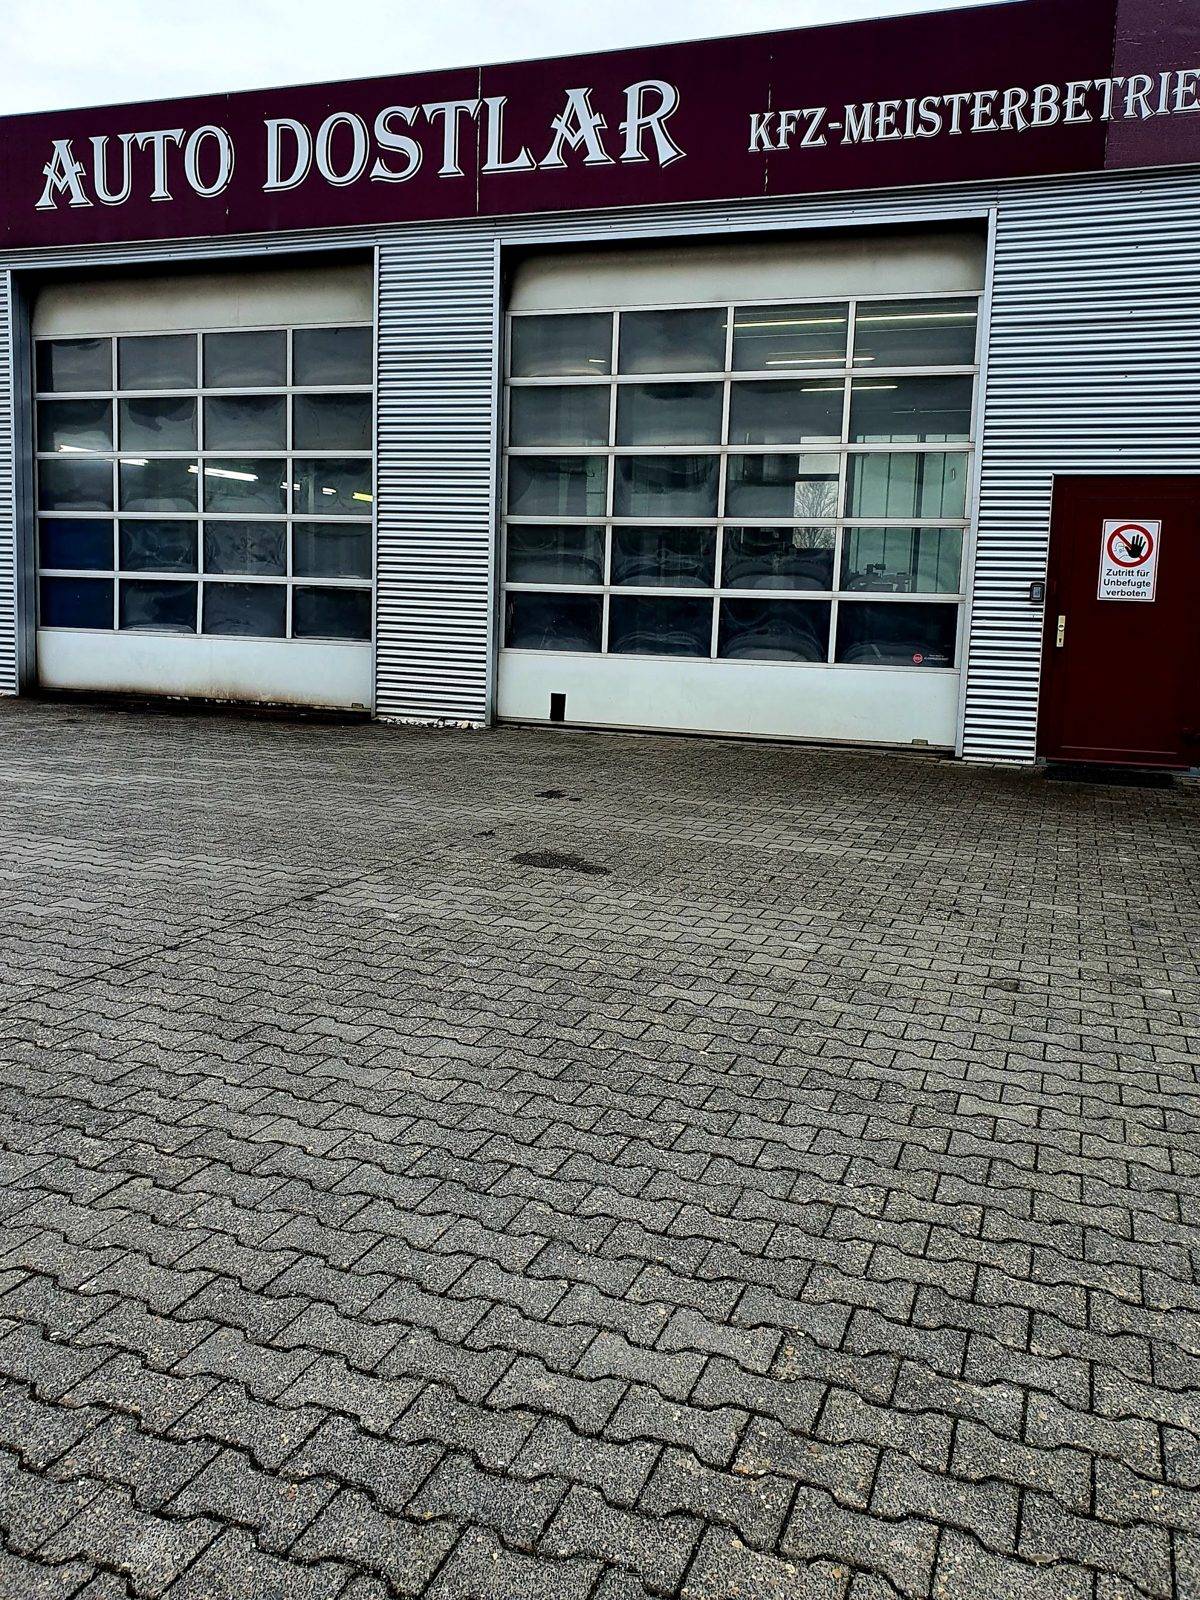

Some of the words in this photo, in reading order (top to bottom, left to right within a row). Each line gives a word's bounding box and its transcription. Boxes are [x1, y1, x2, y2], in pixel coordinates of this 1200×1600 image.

[35, 125, 235, 211] AUTO
[262, 79, 687, 193] DOSTLAR
[1106, 569, 1134, 577] Zutritt
[1136, 569, 1150, 577] für
[1103, 579, 1151, 588] Unbefugte
